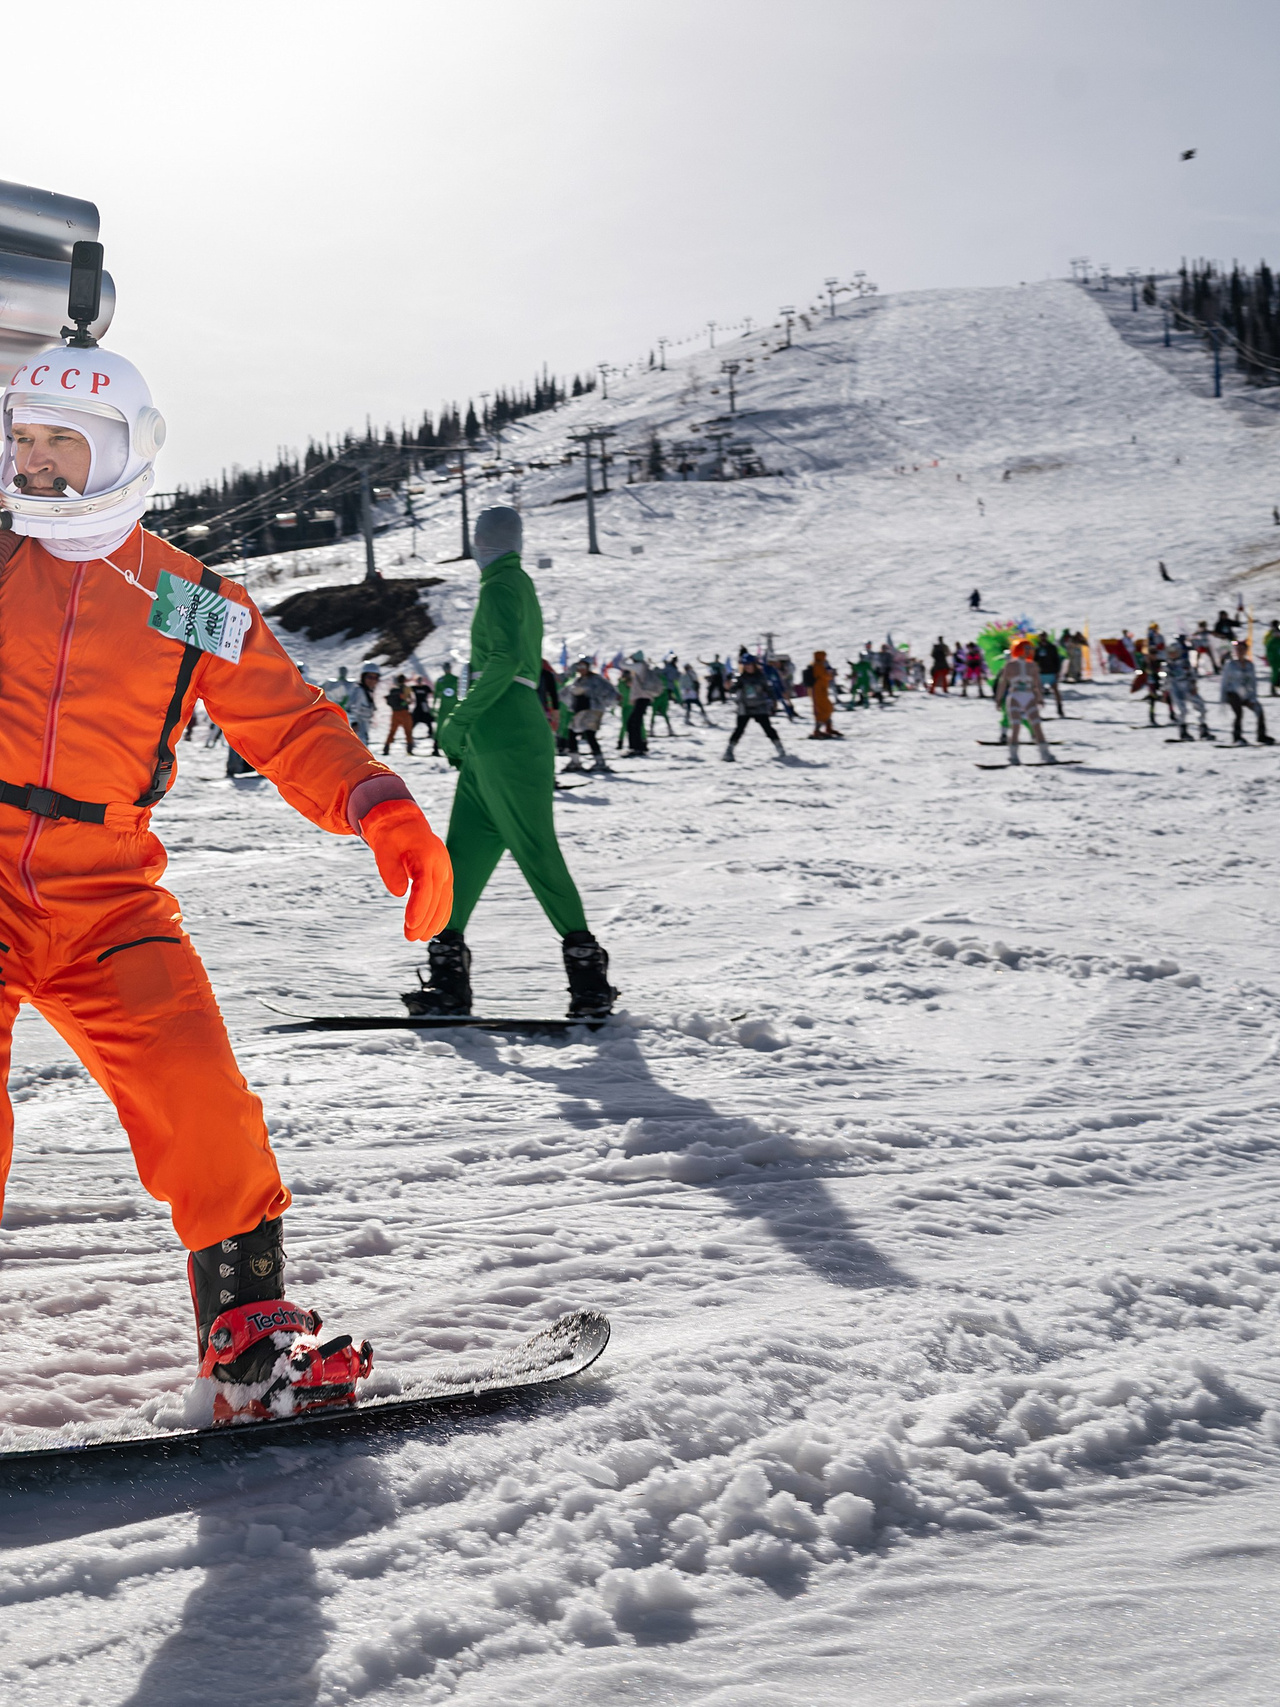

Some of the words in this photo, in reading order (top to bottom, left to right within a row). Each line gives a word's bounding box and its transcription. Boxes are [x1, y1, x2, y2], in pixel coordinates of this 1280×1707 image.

[11, 365, 110, 394] СССР
[205, 612, 218, 636] 400
[246, 1307, 313, 1332] Technine
